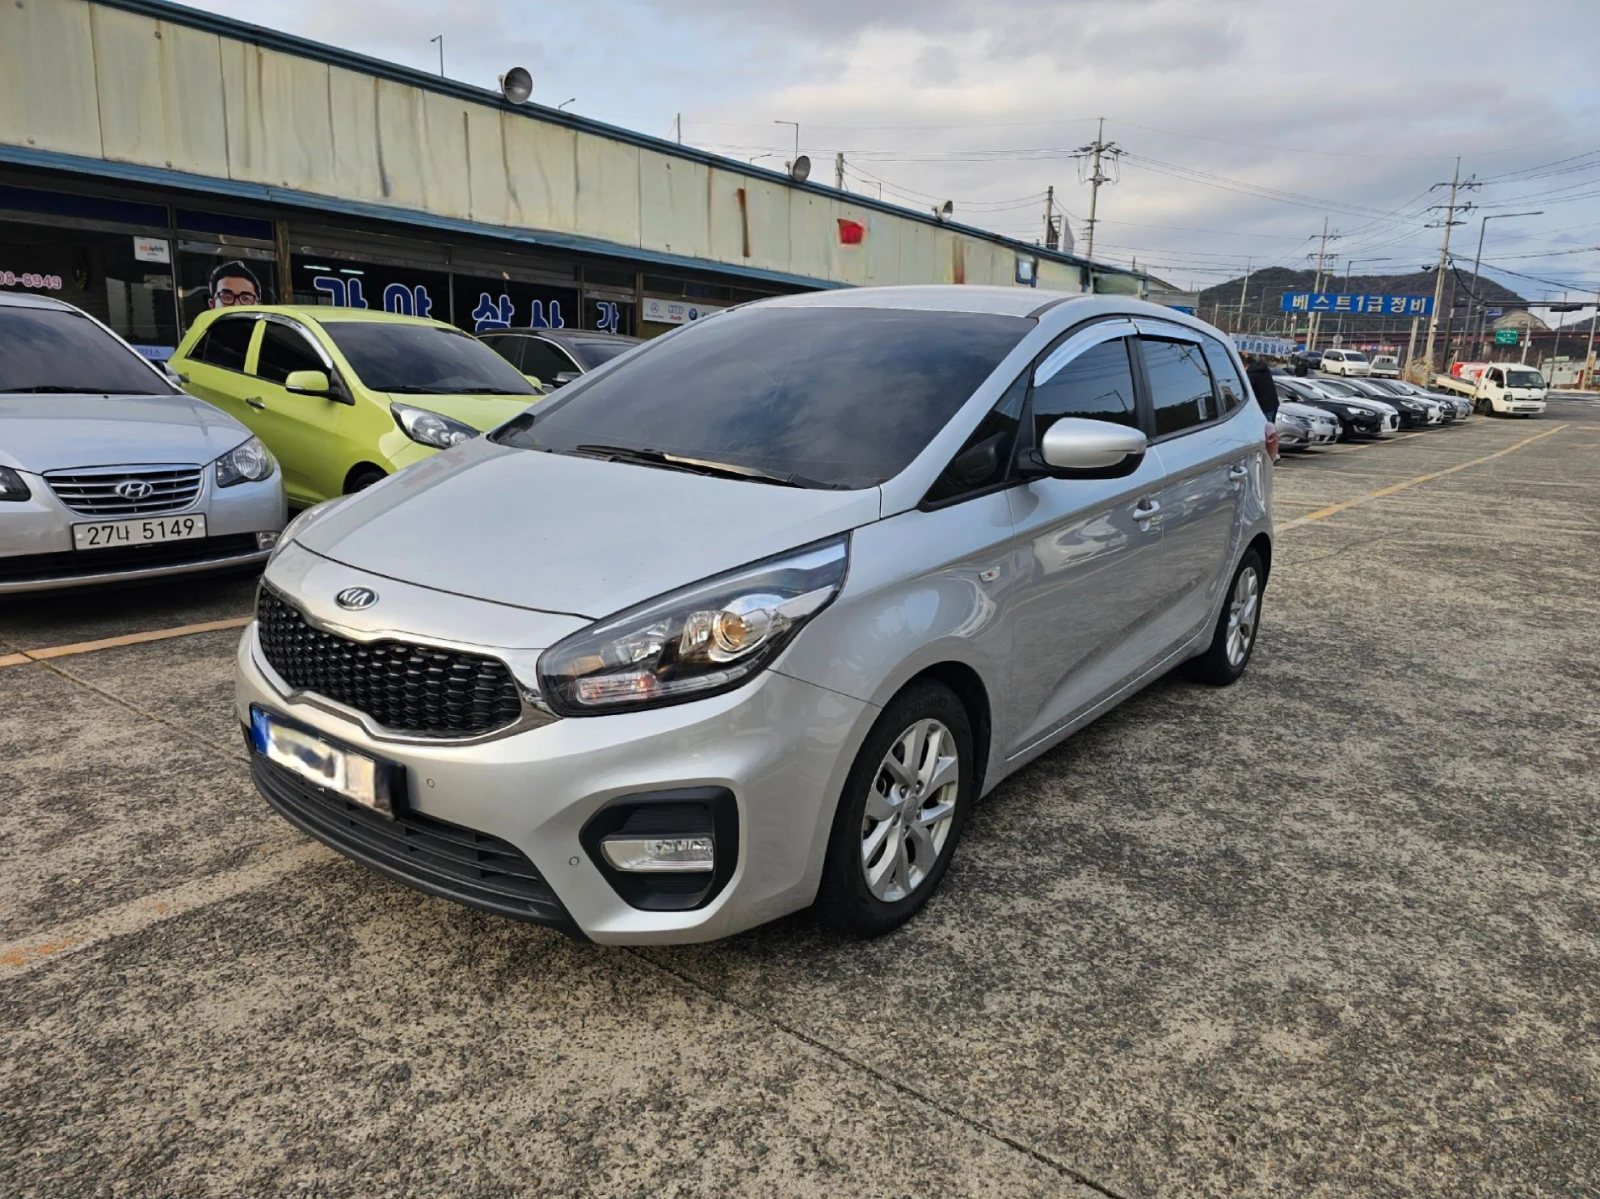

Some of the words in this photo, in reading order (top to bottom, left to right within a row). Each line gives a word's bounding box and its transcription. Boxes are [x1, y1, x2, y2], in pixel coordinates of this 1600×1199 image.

[87, 525, 130, 545] 27나
[143, 518, 195, 539] 5149
[338, 588, 371, 606] KIA
